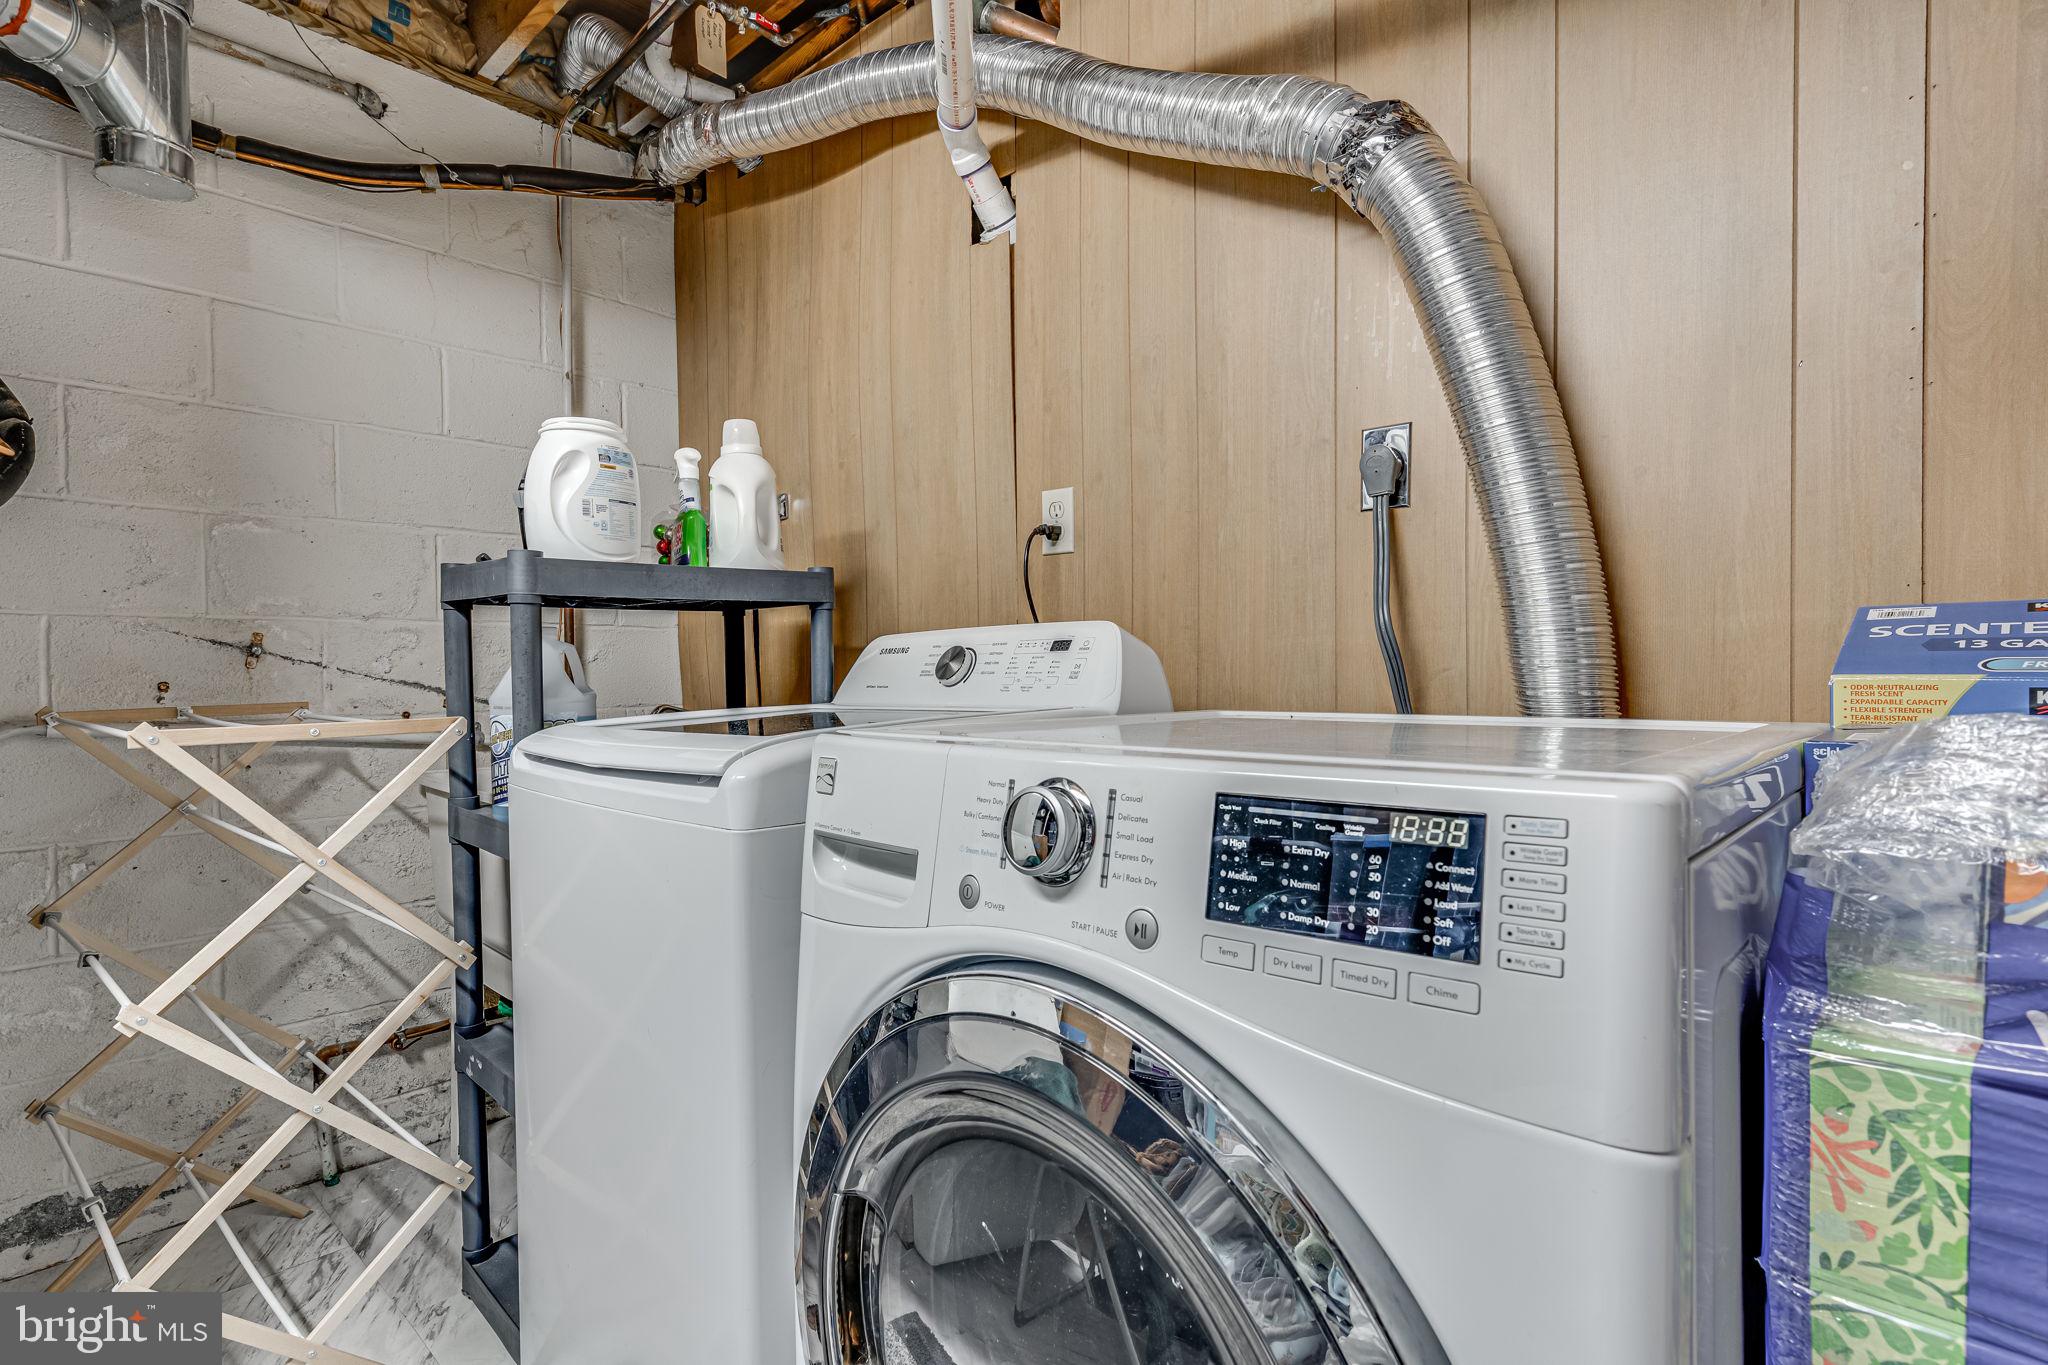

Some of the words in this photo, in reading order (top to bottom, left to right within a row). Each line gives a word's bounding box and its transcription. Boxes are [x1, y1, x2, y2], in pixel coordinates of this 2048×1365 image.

[1953, 639, 1989, 649] 13
[880, 646, 911, 655] SAMSUNG
[988, 780, 1006, 788] Normal
[976, 797, 992, 805] Heavy
[992, 797, 1004, 806] Duty
[1121, 793, 1143, 803] Casual
[1118, 813, 1149, 824] Delicates
[1292, 821, 1303, 829] Dry
[1315, 823, 1336, 833] Cooling
[981, 829, 1000, 840] Sanitize
[1116, 832, 1135, 841] Small
[1136, 834, 1154, 844] Load
[1229, 838, 1247, 850] High
[1114, 851, 1139, 862] Express
[1141, 854, 1154, 865] Dry
[1292, 846, 1313, 857] Extra
[1314, 848, 1330, 859] Dry
[1368, 855, 1383, 865] 60
[1435, 862, 1476, 876] Connect
[1144, 877, 1158, 887] Dry
[1227, 870, 1258, 883] Medium
[1368, 872, 1382, 882] 50
[1518, 876, 1538, 885] More
[1540, 878, 1559, 887] Time
[1290, 878, 1321, 891] Normal
[1434, 882, 1450, 891] Add
[1451, 883, 1474, 894] Water
[1367, 891, 1381, 900] 40
[984, 901, 1006, 912] POWER
[1225, 902, 1241, 912] Low
[1434, 899, 1458, 910] Loud
[1517, 904, 1534, 912] Less
[1536, 905, 1556, 914] Time
[1366, 907, 1380, 917] 30
[1288, 912, 1313, 926] Damp
[1314, 915, 1330, 928] Dry
[1433, 917, 1455, 929] Soft
[1071, 920, 1091, 932] START
[1095, 923, 1119, 938] PAUSE
[1366, 925, 1379, 935] 20
[1433, 935, 1452, 947] Off
[1218, 946, 1239, 959] Temp
[1273, 957, 1288, 969] Dry
[1291, 960, 1313, 973] Level
[1340, 970, 1368, 984] Timed
[1371, 976, 1389, 988] Dry
[1425, 986, 1458, 1000] Chime
